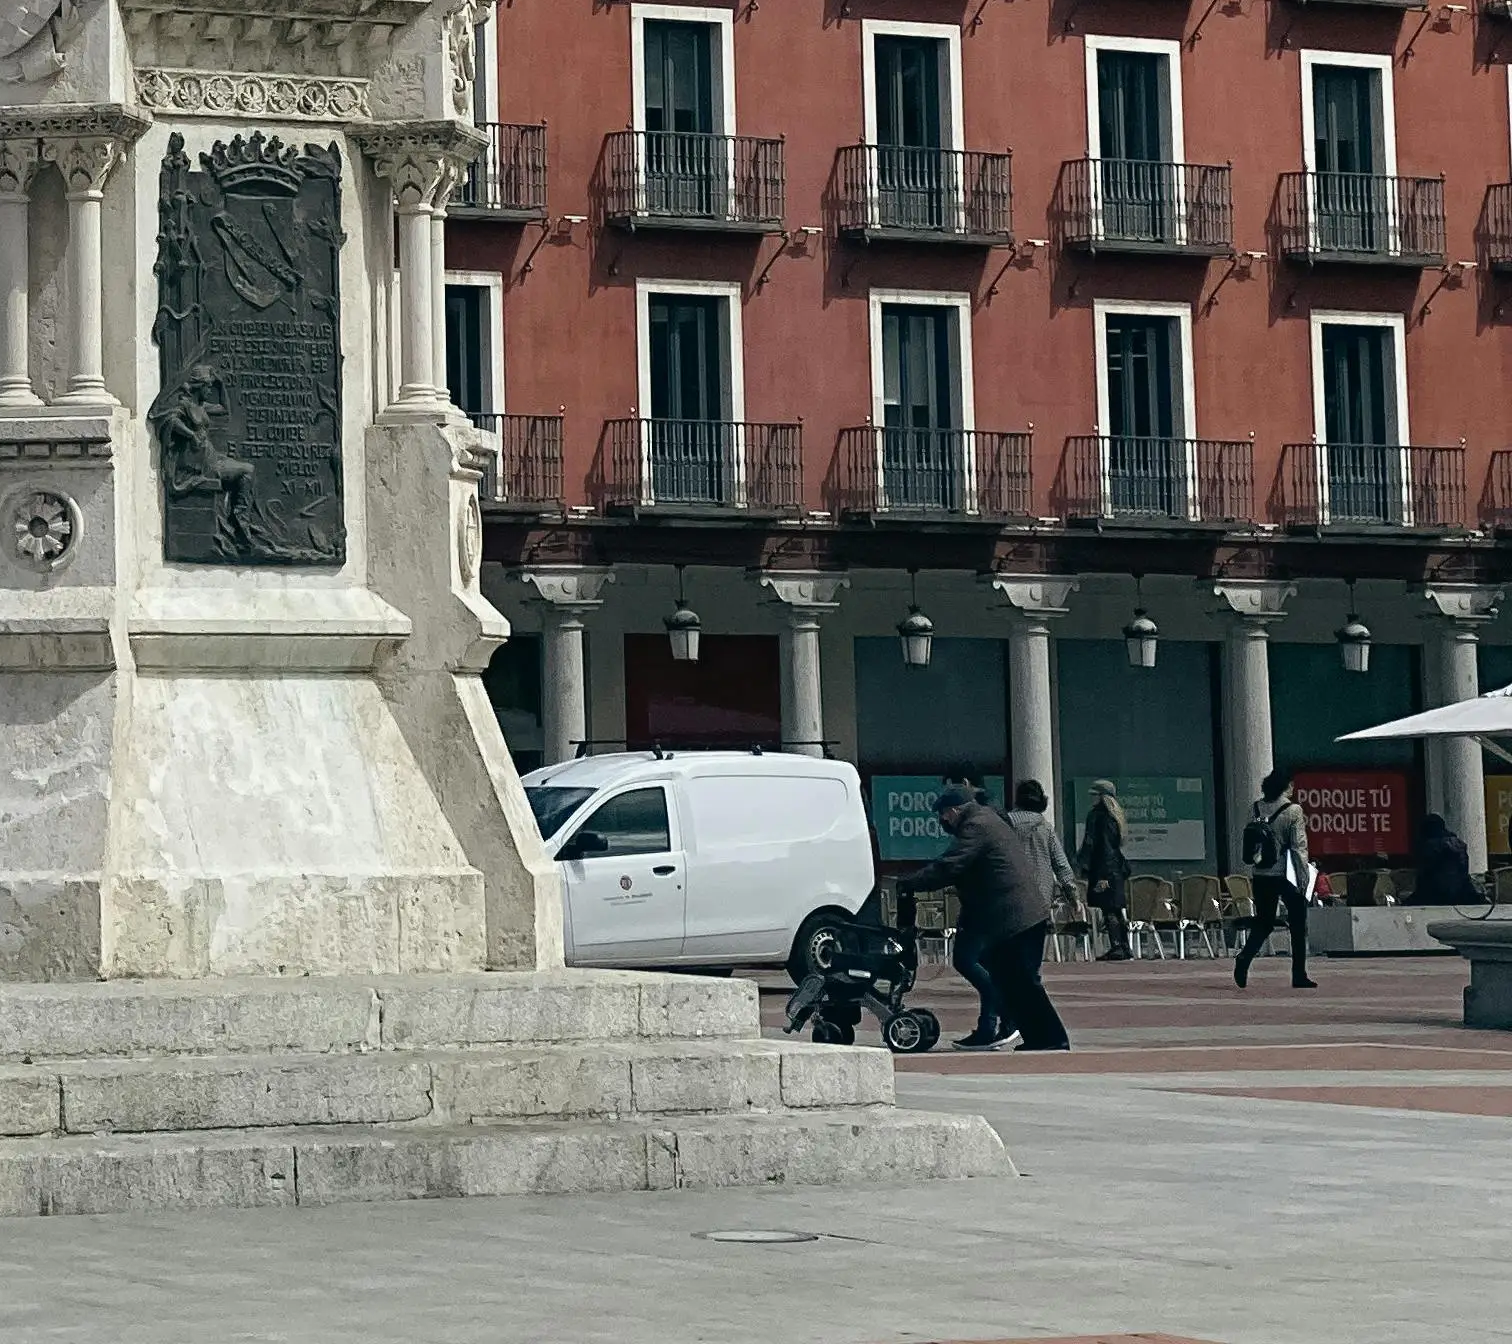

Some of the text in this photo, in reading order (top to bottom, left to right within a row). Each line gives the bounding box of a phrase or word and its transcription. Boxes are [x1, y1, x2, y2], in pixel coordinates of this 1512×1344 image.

[1297, 784, 1392, 810] PORQUE TÚ
[889, 817, 949, 838] PORQ
[1371, 813, 1391, 833] TE
